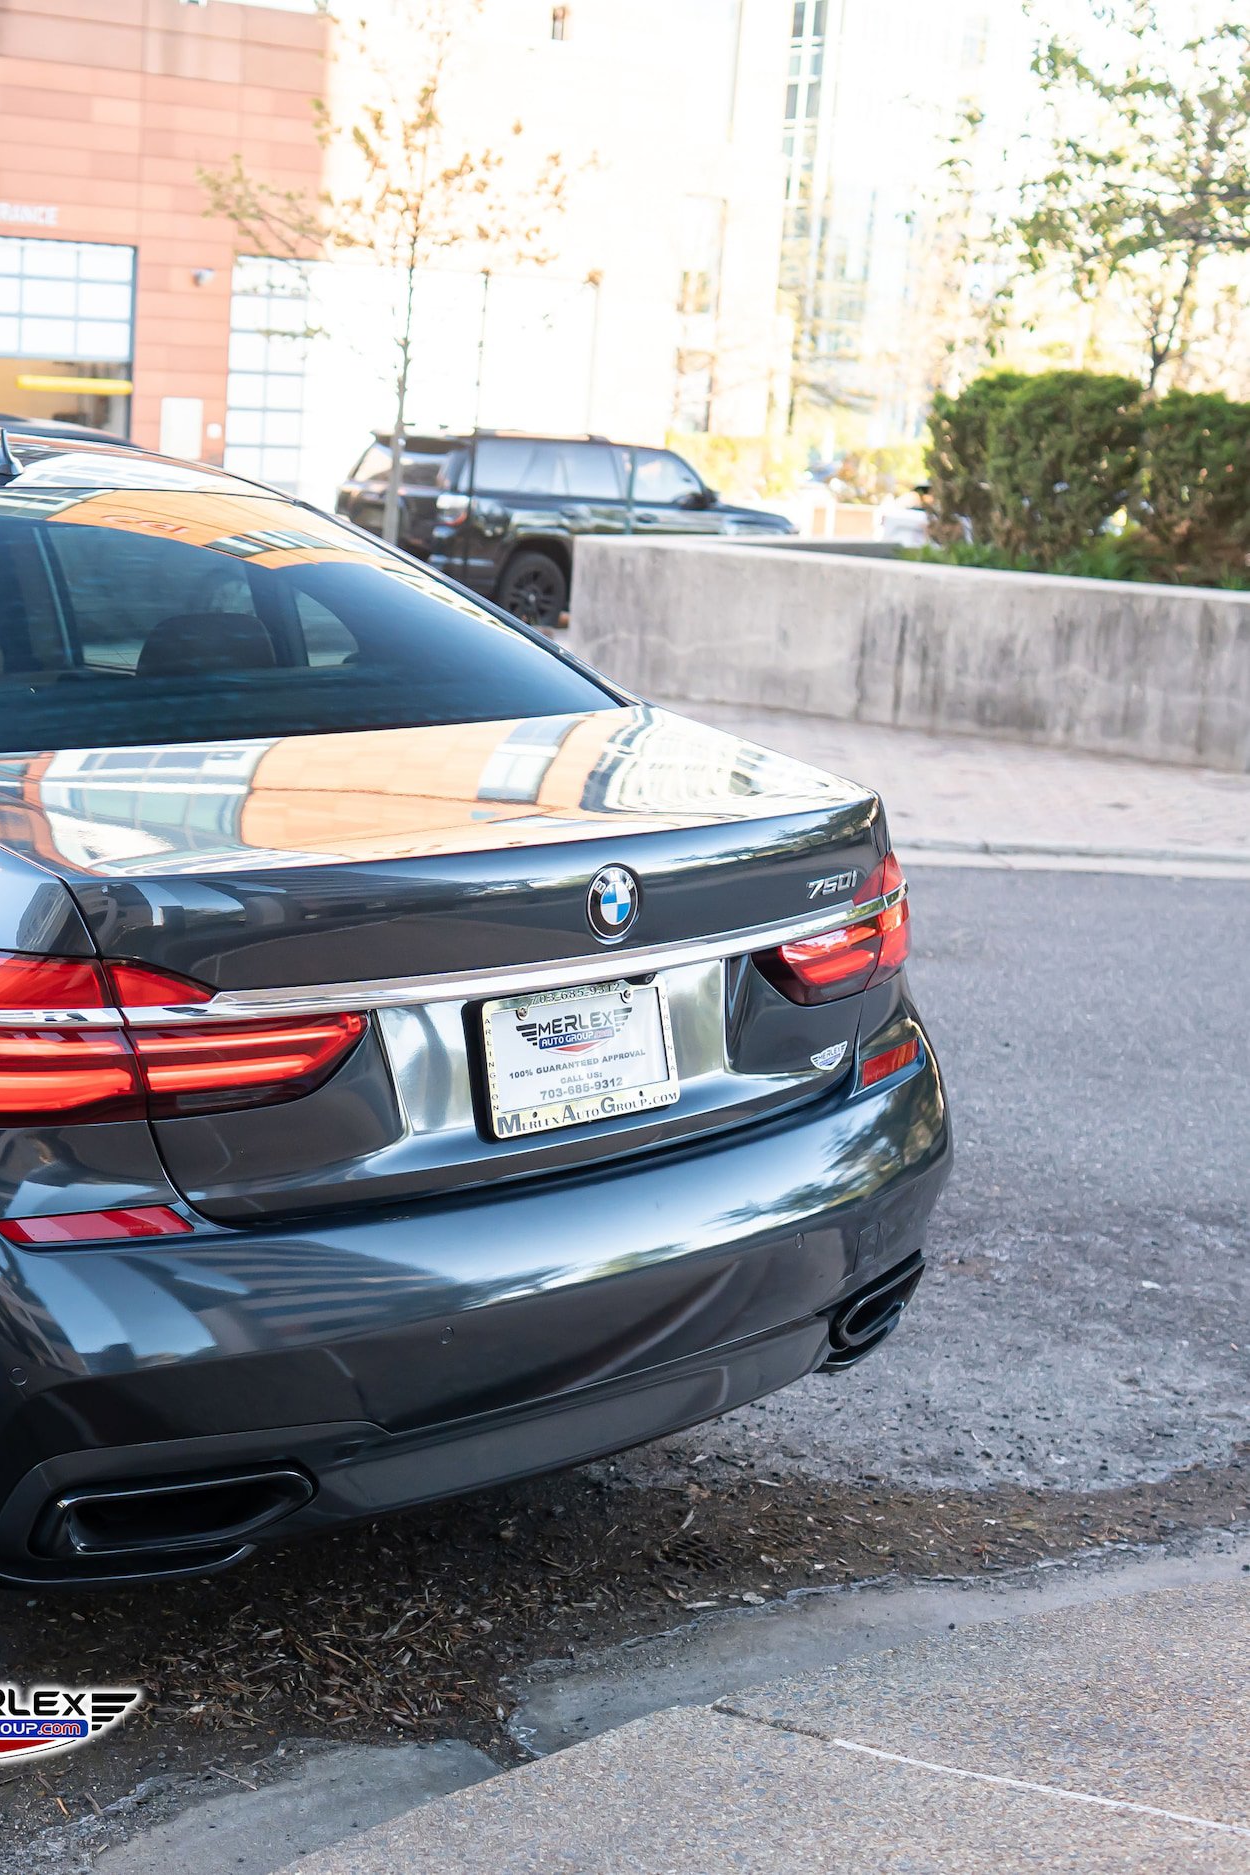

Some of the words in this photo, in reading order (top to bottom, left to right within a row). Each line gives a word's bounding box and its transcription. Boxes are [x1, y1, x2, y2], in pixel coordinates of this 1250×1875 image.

[593, 870, 634, 895] BMW
[531, 982, 620, 1005] 703-685-9312
[538, 1011, 613, 1037] MERLEX
[541, 1037, 564, 1048] AUTO
[509, 1068, 533, 1079] 100%
[536, 1058, 599, 1074] GUARANTEED
[602, 1049, 646, 1063] APPROVAL
[540, 1077, 623, 1100] 703-685-9312
[560, 1074, 584, 1084] CALL
[586, 1071, 603, 1080] US:
